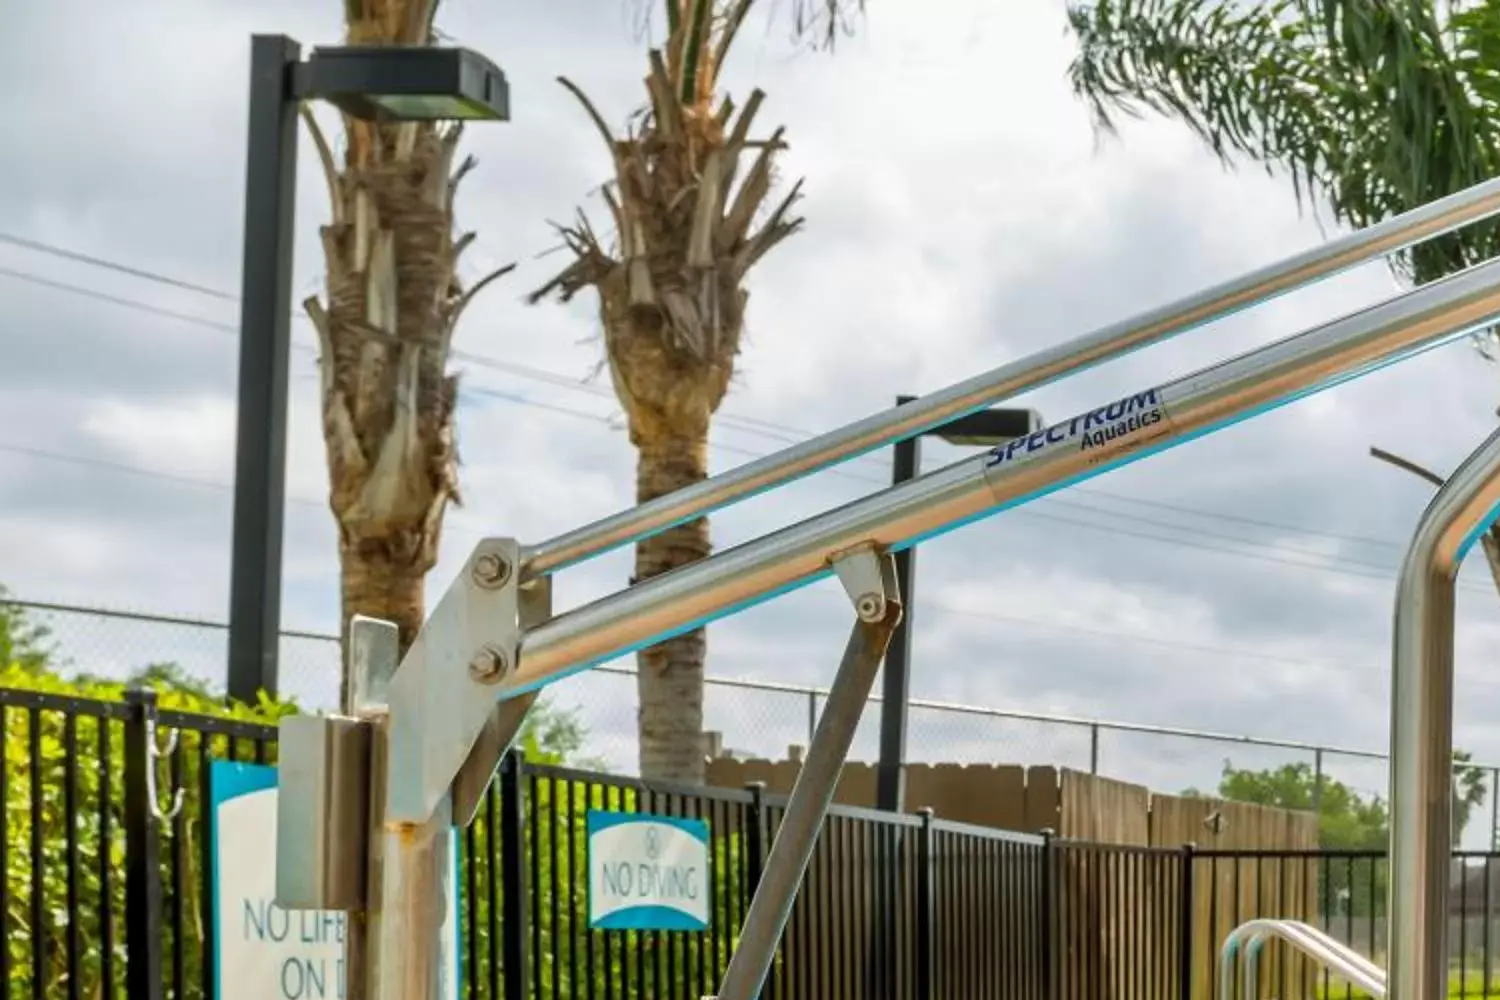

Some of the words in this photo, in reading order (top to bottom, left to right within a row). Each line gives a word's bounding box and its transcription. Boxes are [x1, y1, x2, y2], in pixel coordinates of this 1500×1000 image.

[985, 388, 1157, 468] SPECTRUM
[1081, 407, 1161, 450] Aquatics
[602, 861, 632, 897] NO
[638, 863, 698, 900] DIVING
[243, 898, 290, 943] NO
